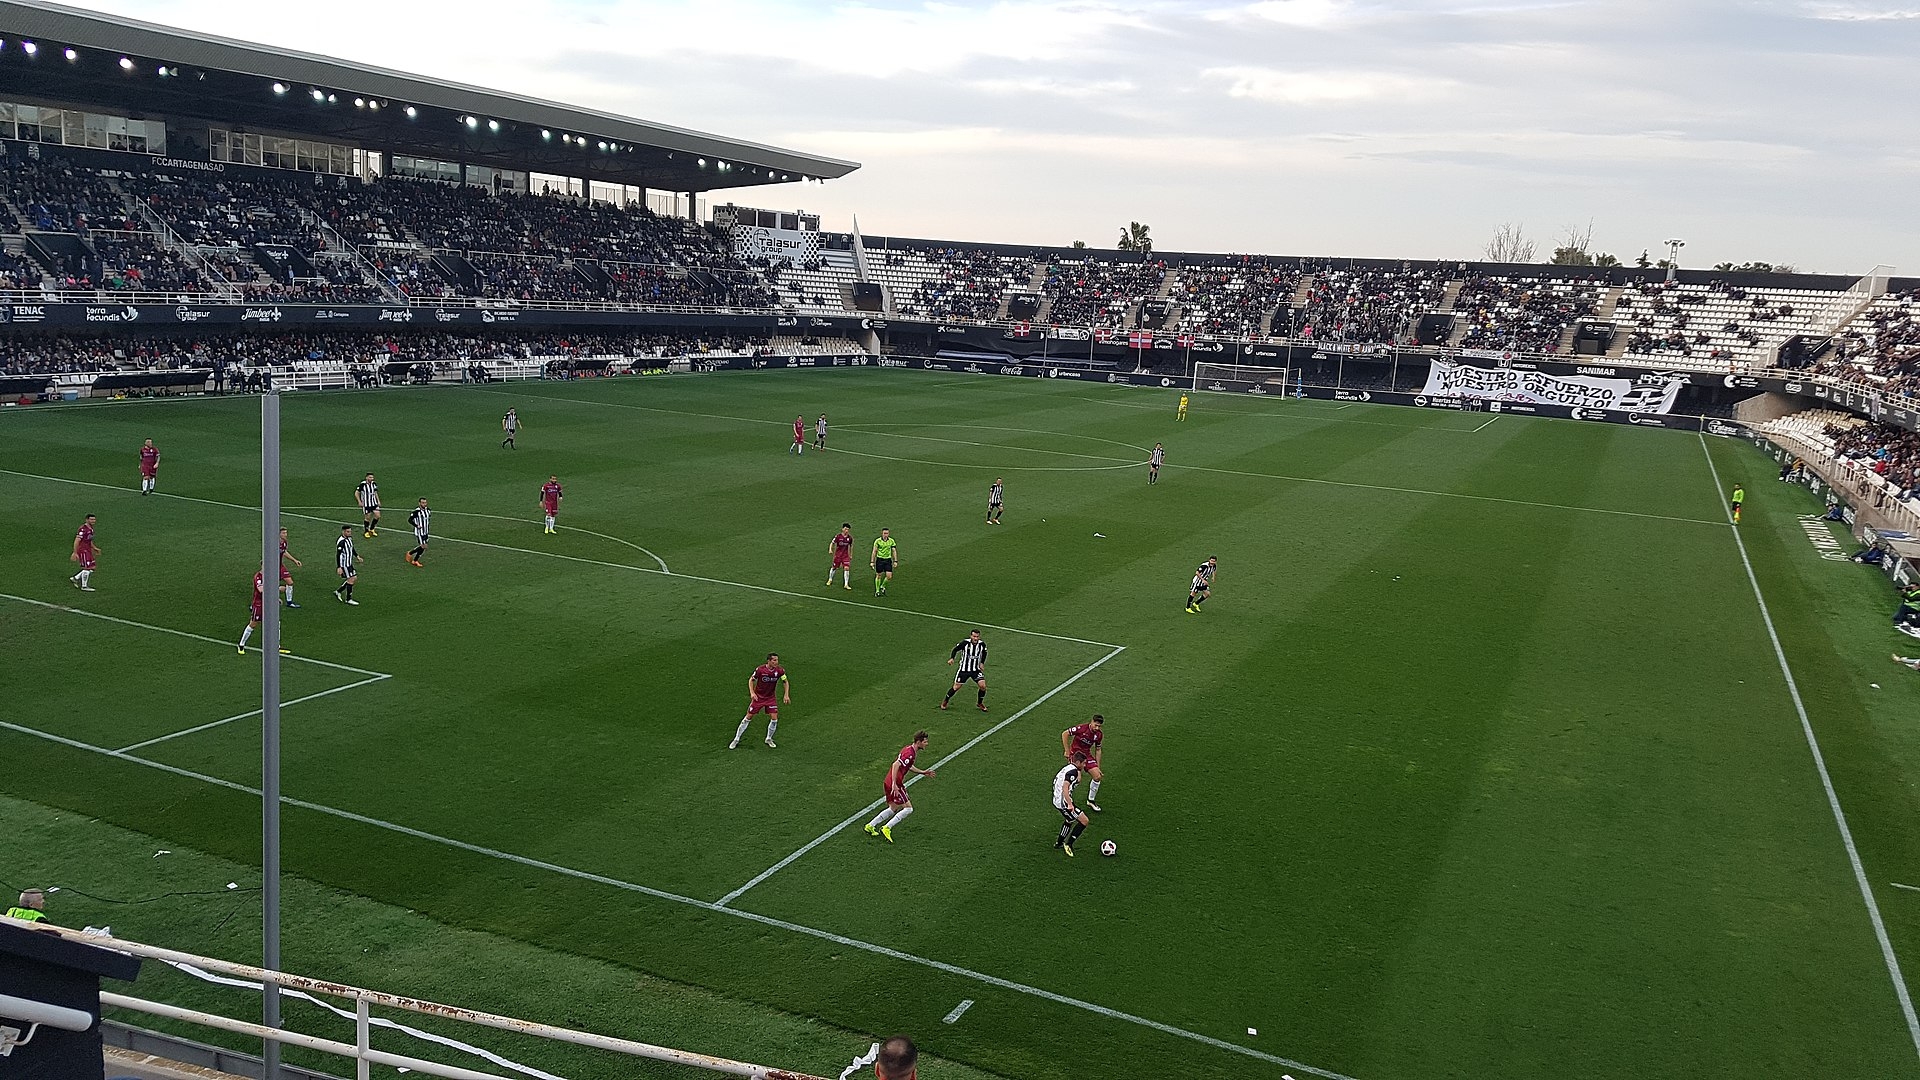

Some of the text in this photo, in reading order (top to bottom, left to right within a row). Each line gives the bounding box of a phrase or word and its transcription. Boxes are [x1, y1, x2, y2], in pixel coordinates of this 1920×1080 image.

[758, 238, 802, 249] Talasur
[761, 246, 783, 254] group
[13, 306, 45, 315] TENAC
[86, 306, 106, 314] terra
[180, 310, 211, 318] Talasur
[241, 308, 272, 320] Jimbee
[86, 313, 120, 322] fecundis
[1576, 366, 1616, 376] SANIMAR
[1521, 372, 1617, 401] ESFUERZO,
[1441, 377, 1612, 409] NUESTRO ORGULLO!
